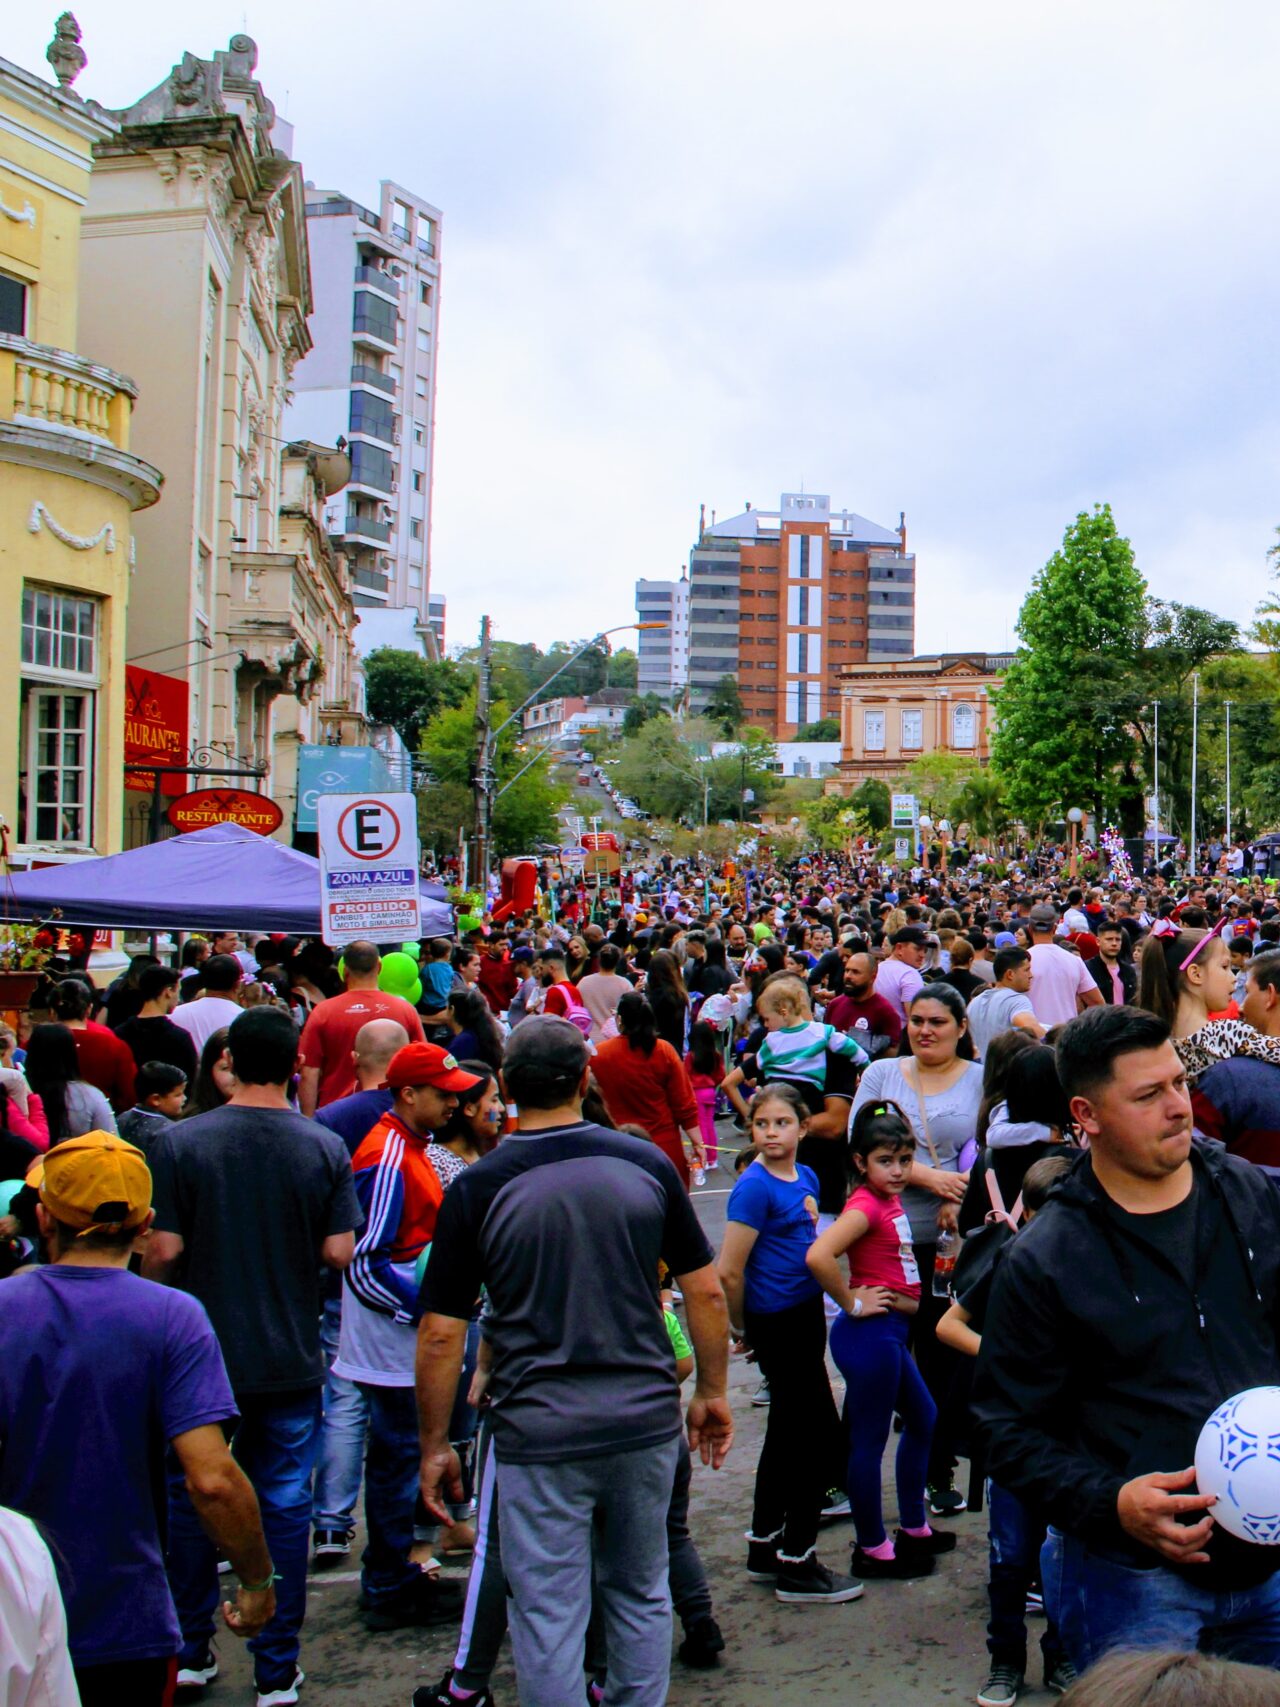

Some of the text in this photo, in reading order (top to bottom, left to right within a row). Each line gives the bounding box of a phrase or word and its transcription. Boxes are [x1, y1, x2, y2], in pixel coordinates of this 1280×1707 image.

[176, 810, 274, 825] RESTAURANTE
[355, 808, 383, 852] E
[331, 871, 410, 885] ZONA AZUL
[335, 901, 410, 913] PROIBIDO
[337, 921, 360, 929] MOTO
[369, 918, 411, 927] SIMILARES
